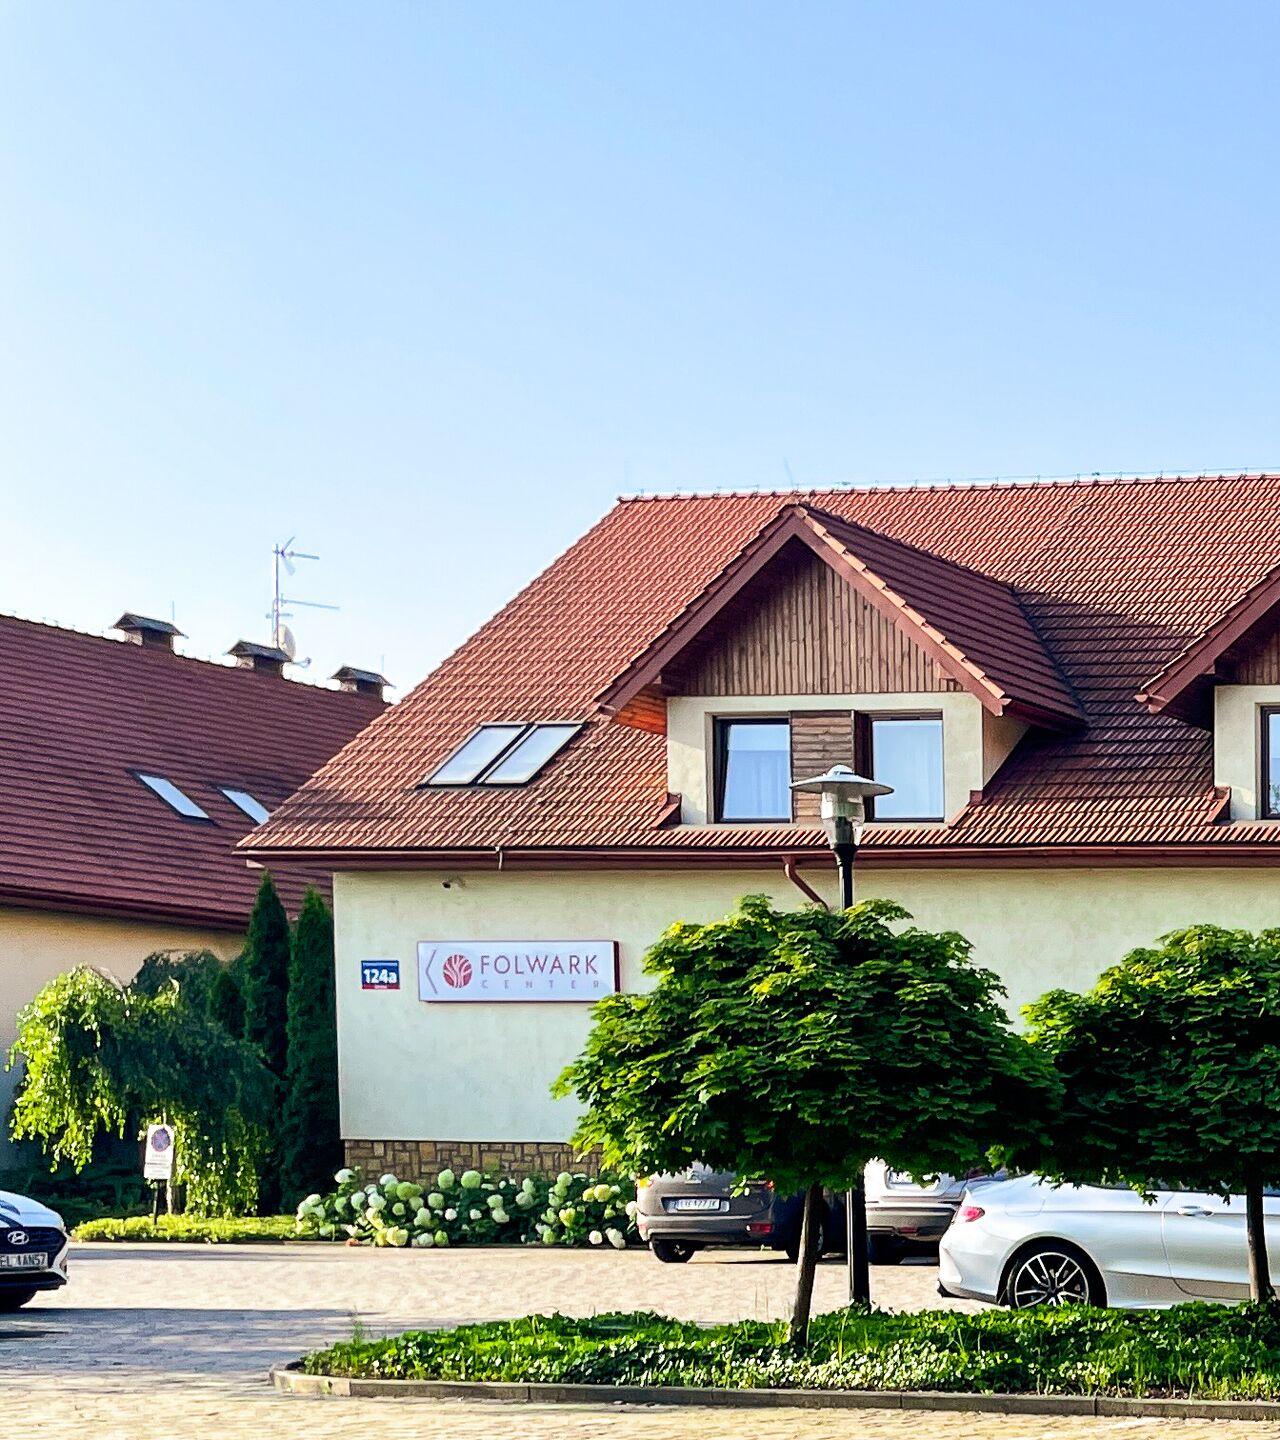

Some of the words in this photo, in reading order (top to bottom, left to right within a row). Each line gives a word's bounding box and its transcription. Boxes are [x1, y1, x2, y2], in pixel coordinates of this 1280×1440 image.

[480, 954, 598, 975] FOLWARK
[363, 969, 397, 984] 124a
[480, 980, 600, 989] CENTER
